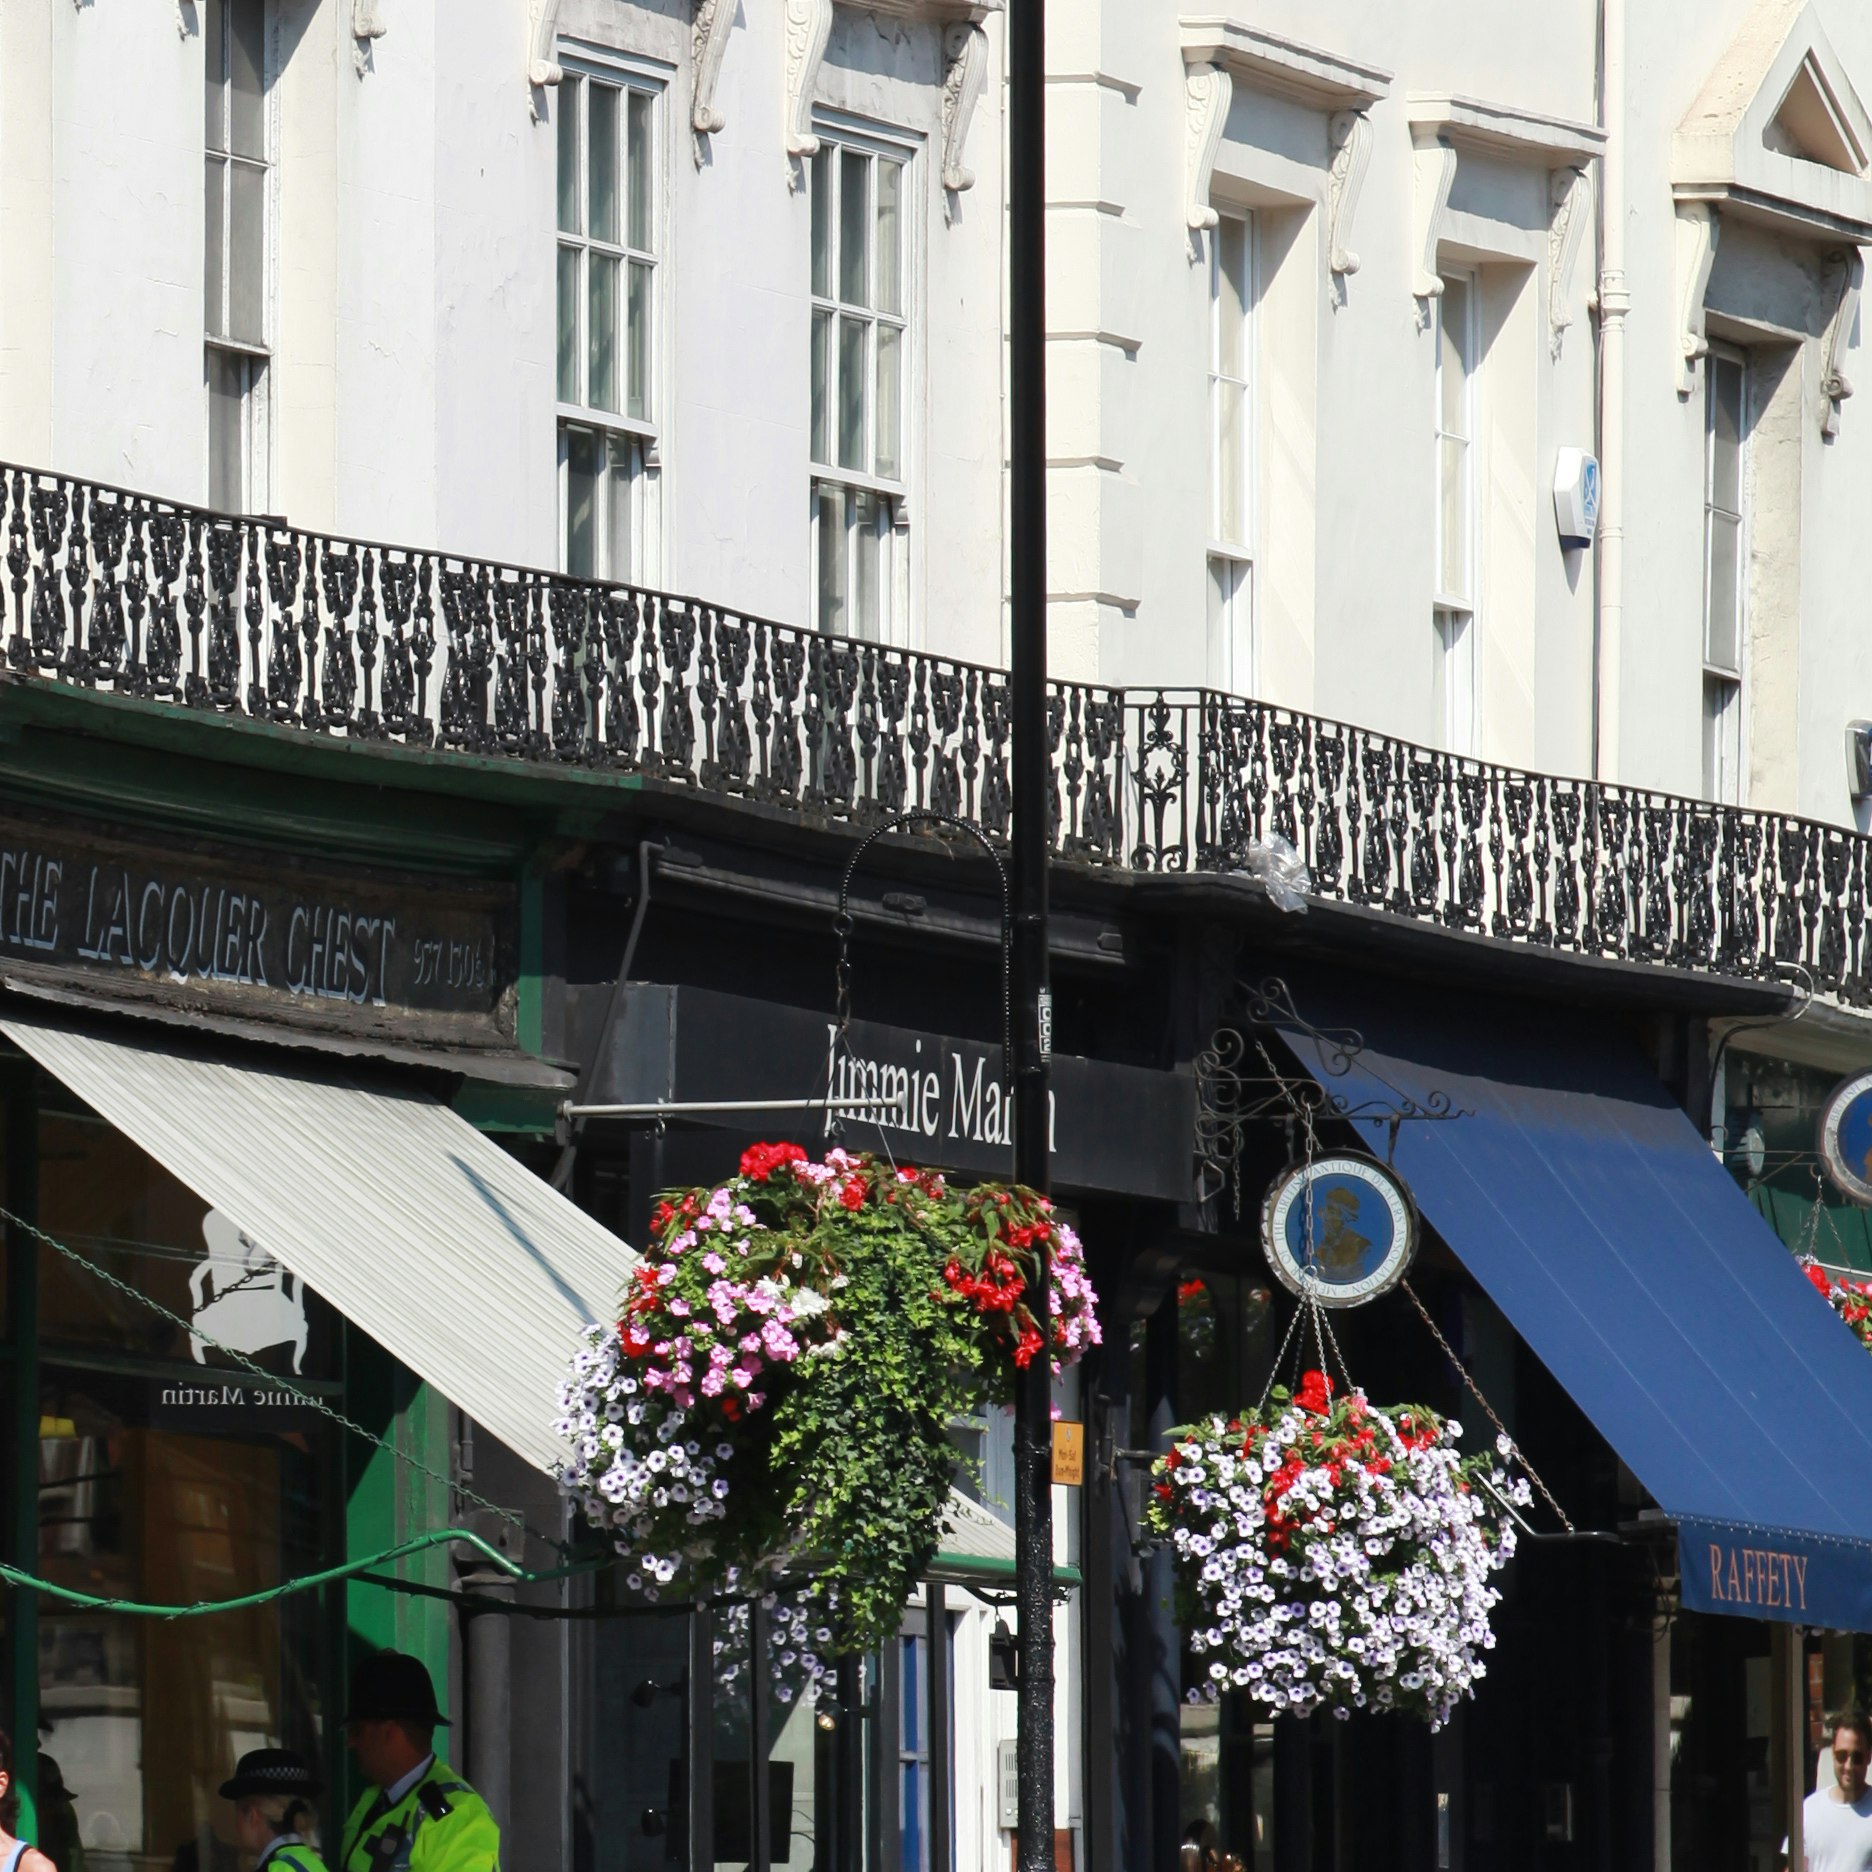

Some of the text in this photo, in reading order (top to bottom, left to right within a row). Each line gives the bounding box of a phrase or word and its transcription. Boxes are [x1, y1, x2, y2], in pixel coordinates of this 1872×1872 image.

[78, 865, 269, 987] LACQUER
[286, 905, 396, 1007] CHEST
[1274, 1220, 1285, 1242] THE
[1312, 1161, 1368, 1177] ANTIQUE
[1351, 1228, 1405, 1293] ASSOCIATION
[1709, 1544, 1809, 1610] RAFFETY
